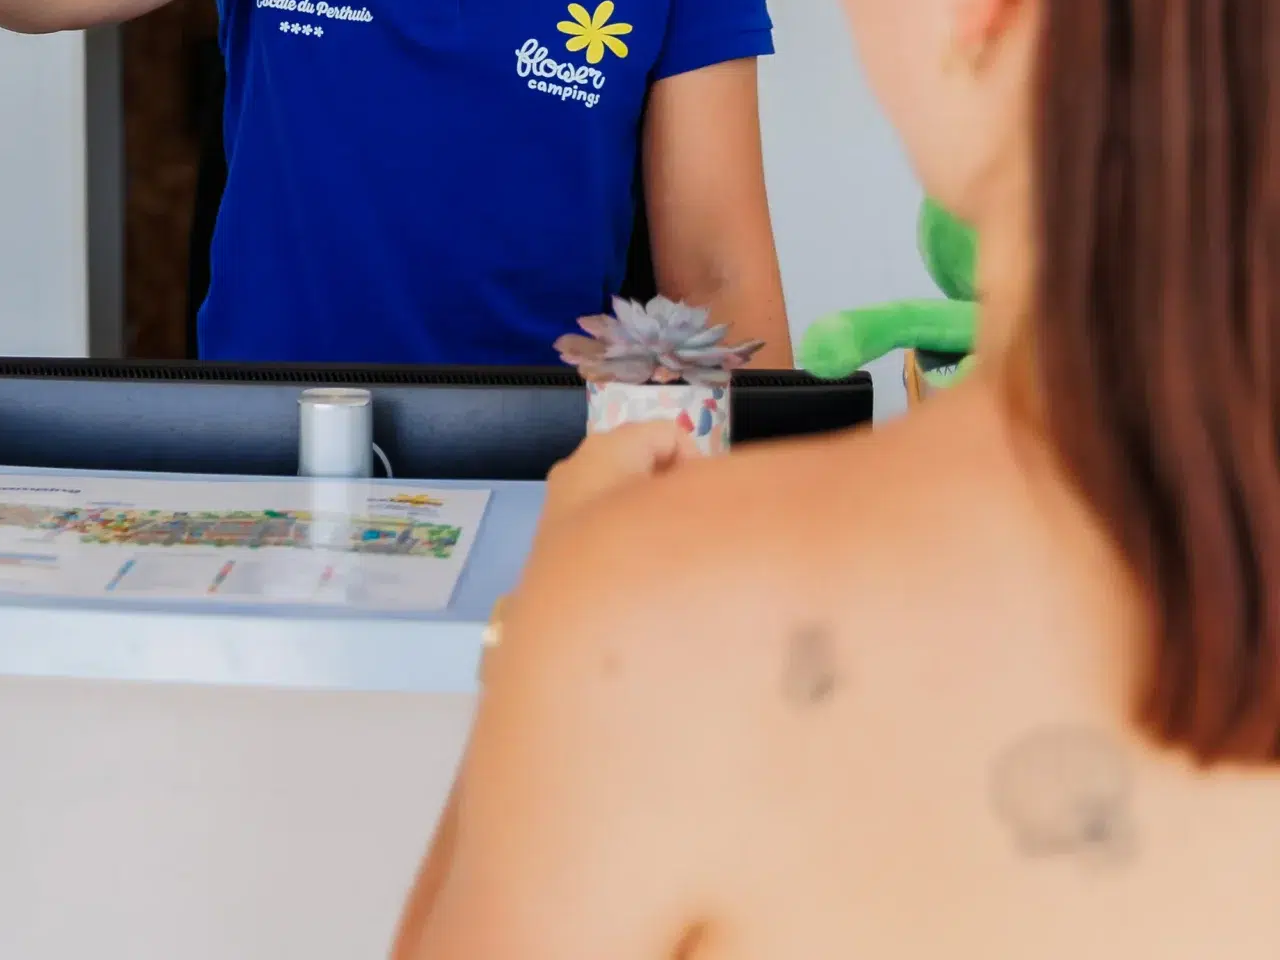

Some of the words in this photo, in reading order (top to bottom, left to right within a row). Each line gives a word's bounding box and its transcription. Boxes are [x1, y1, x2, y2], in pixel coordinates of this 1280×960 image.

[316, 1, 373, 22] Perthuis
[515, 38, 606, 90] flower
[527, 79, 600, 108] campings
